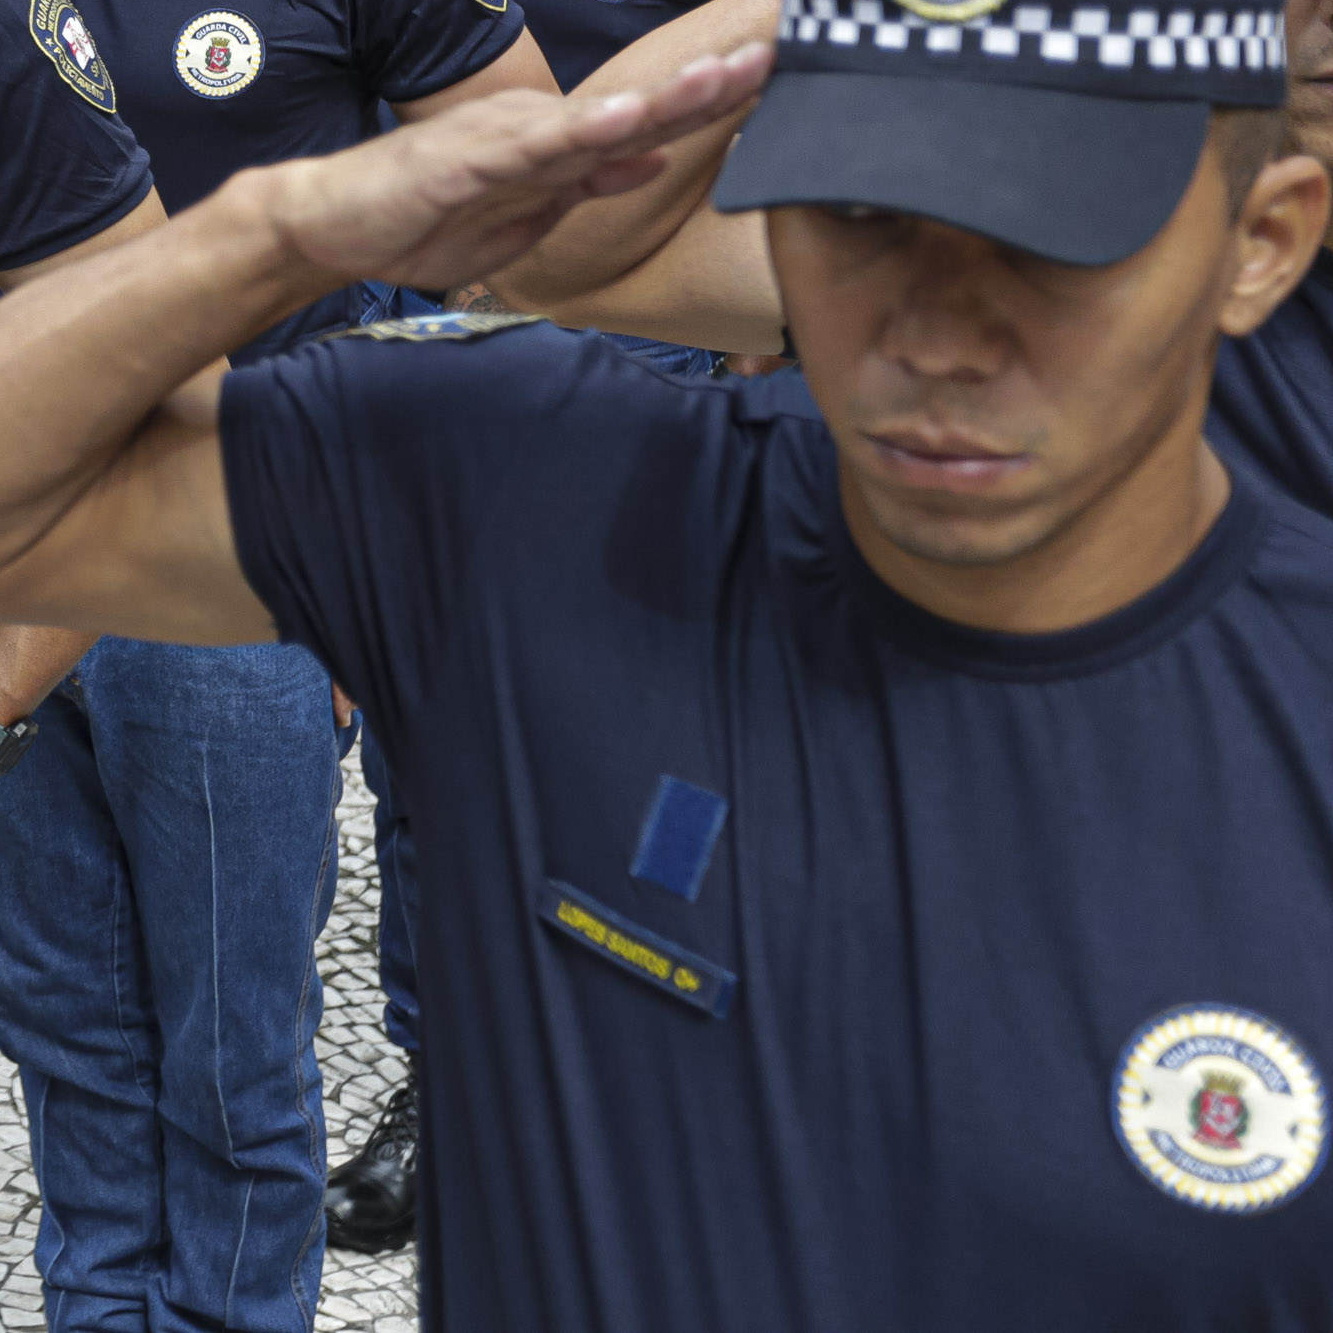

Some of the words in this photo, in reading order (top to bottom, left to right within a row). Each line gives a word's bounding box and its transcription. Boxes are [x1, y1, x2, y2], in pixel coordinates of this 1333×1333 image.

[196, 24, 226, 39] GUARDA
[229, 26, 246, 44] CIVIL
[1163, 1038, 1235, 1067] GUARDA
